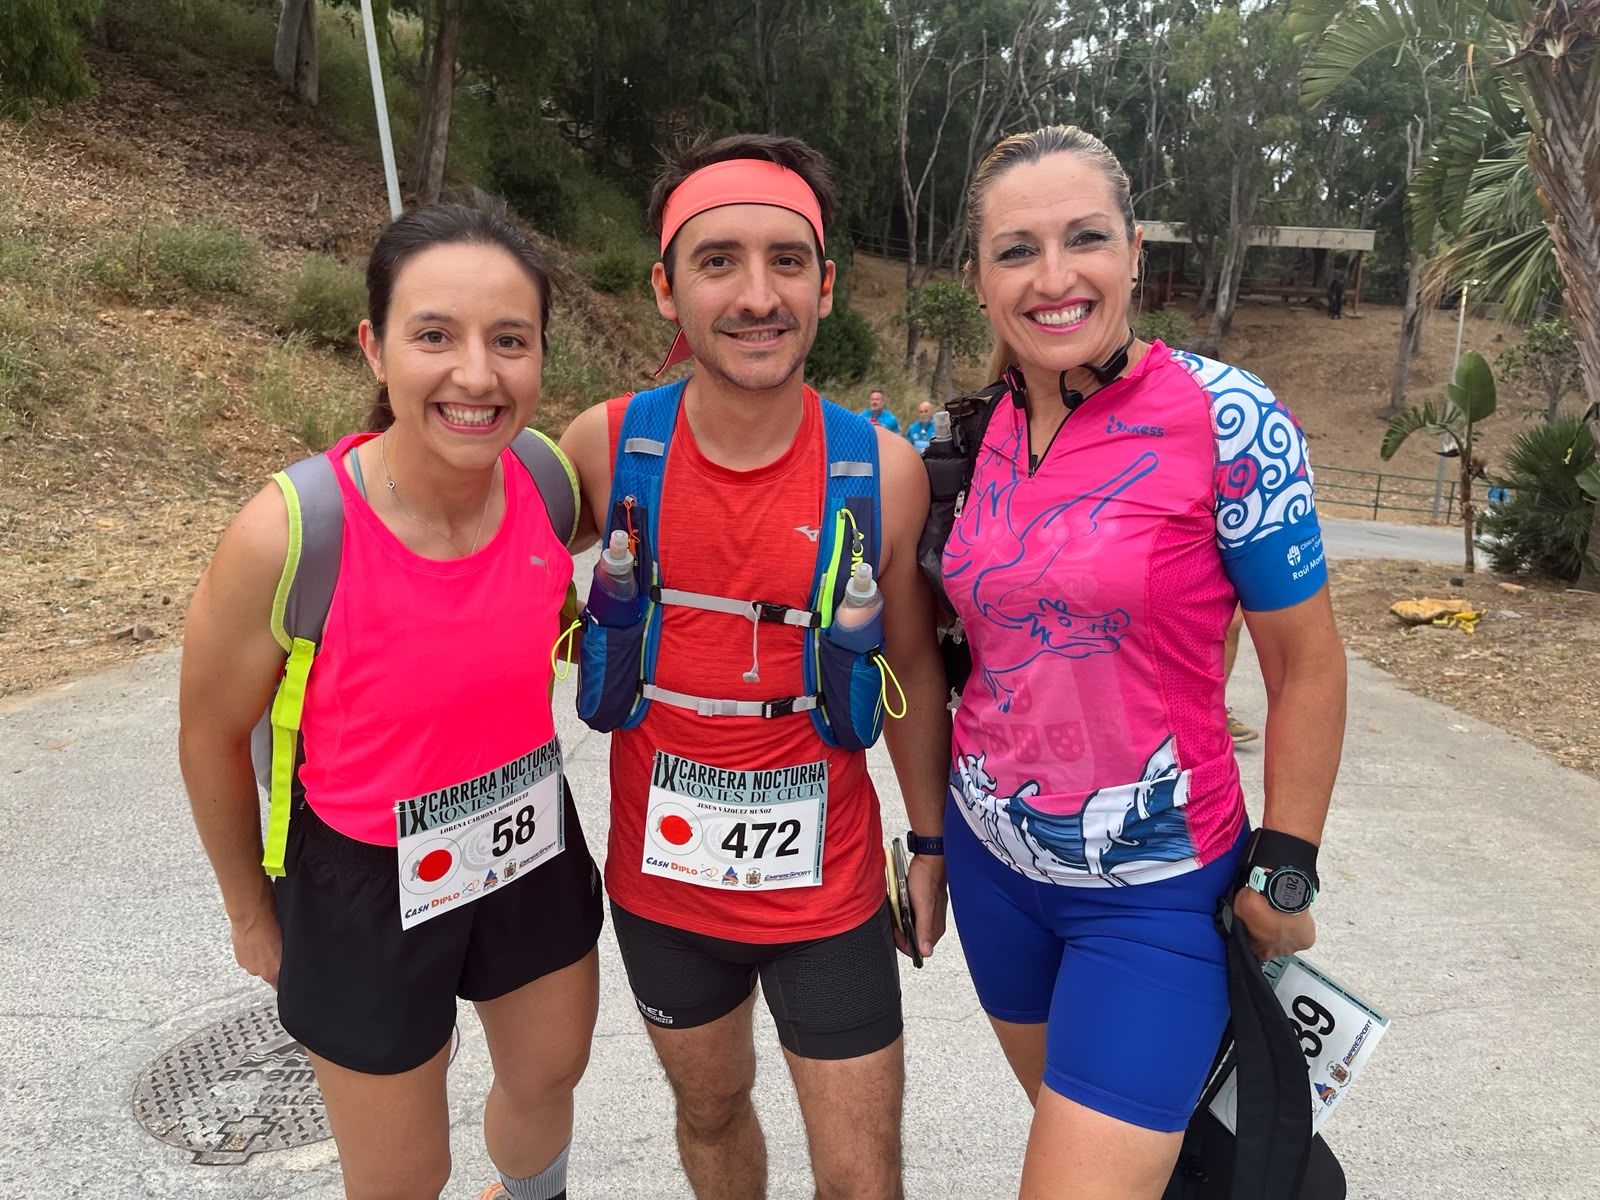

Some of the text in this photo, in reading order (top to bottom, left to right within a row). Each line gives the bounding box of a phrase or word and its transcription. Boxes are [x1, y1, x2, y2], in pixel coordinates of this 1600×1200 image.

[1292, 564, 1310, 580] Raúl
[652, 751, 826, 793] IX CARRERA NOCTURNA
[399, 741, 562, 838] IX CARRERA NOCTURNA
[430, 757, 562, 827] MONTES DE CEUTA
[677, 779, 826, 804] MONTES DE CEUTA
[440, 821, 468, 835] LORENA
[467, 809, 498, 826] CARMONA
[697, 803, 773, 815] JESÚS VÁZQUEZ MUÑOZ
[491, 804, 536, 858] 58
[720, 819, 802, 860] 472
[645, 856, 699, 876] CASH DIPLO
[404, 892, 461, 919] CASH DIPLO
